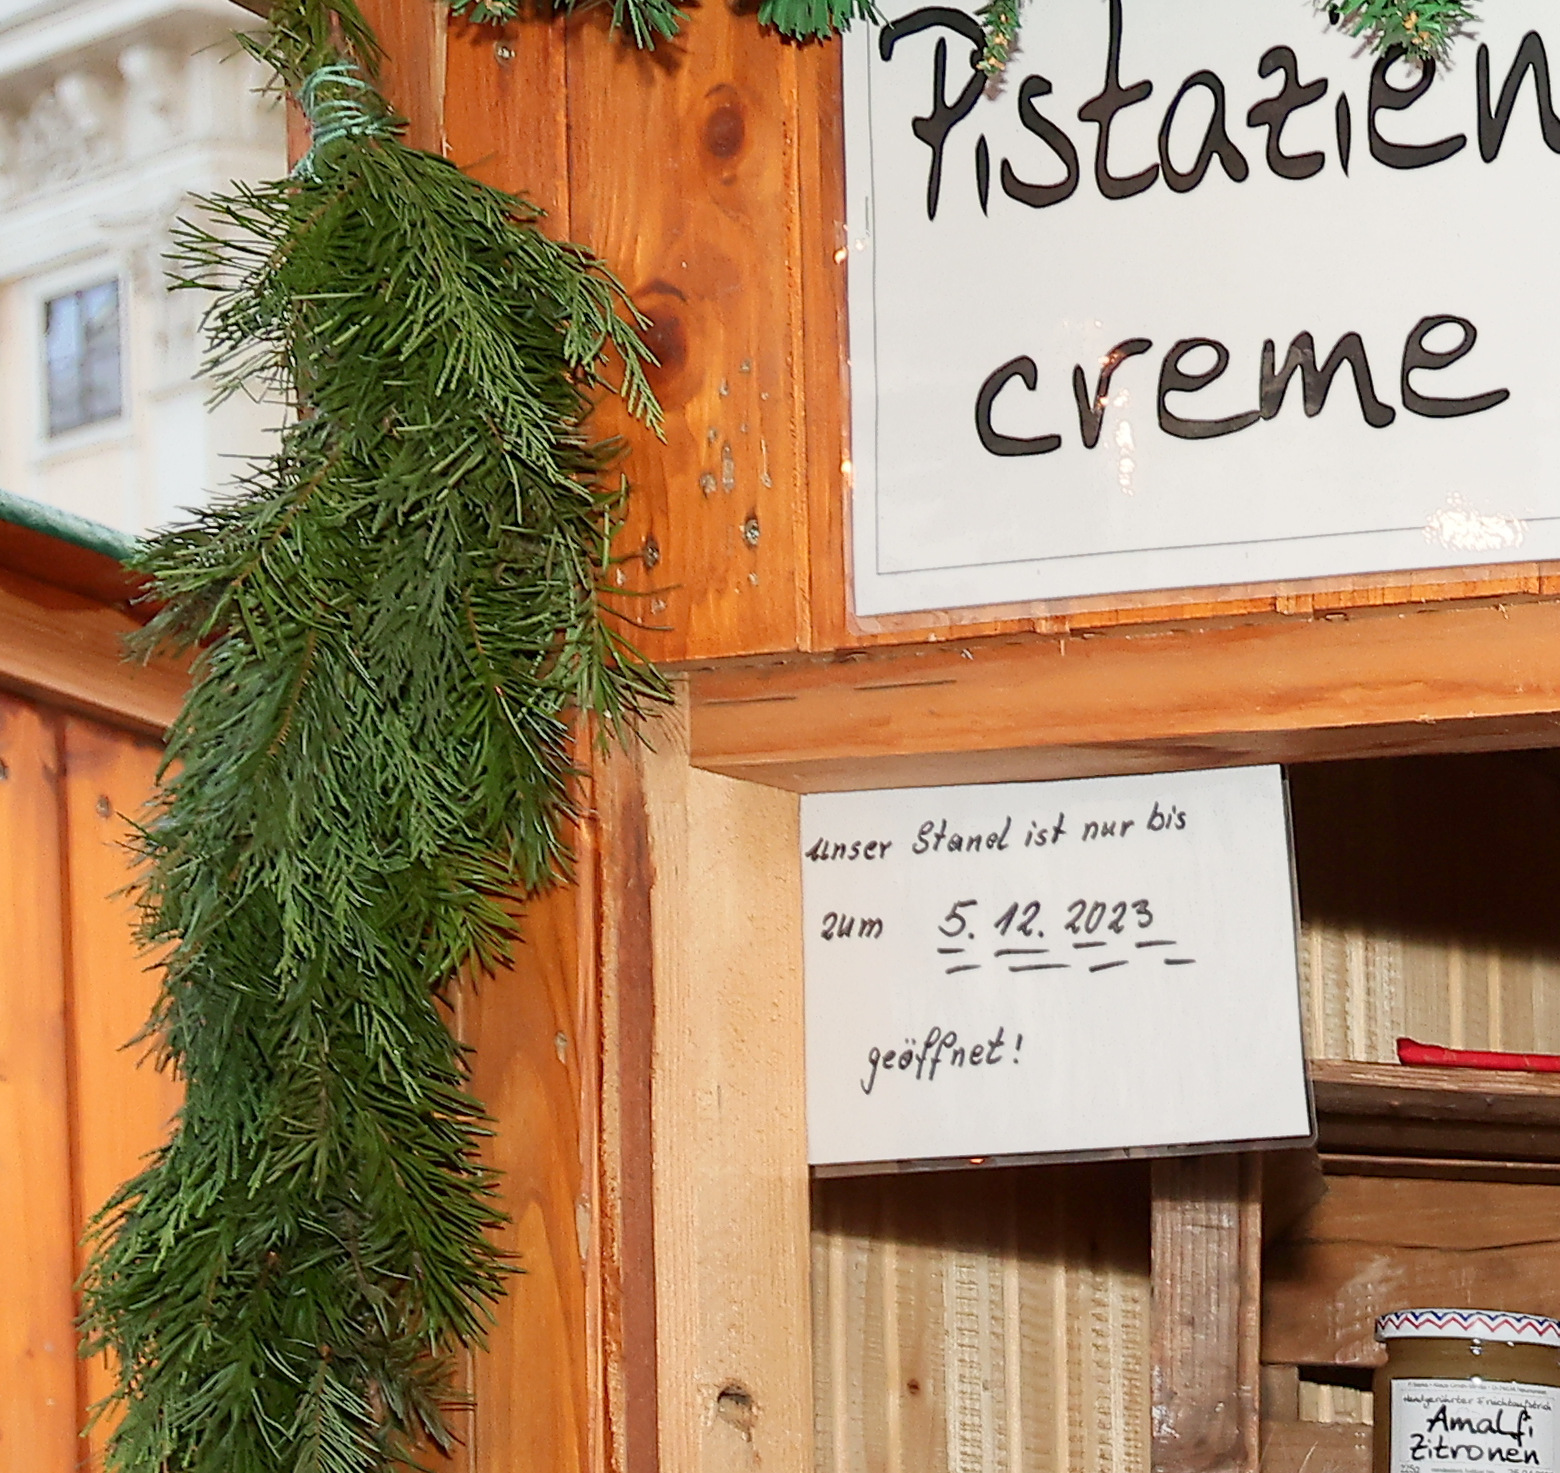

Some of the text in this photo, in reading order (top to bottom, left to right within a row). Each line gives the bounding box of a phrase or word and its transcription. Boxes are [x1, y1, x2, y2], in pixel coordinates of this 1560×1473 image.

[974, 313, 1510, 457] creme
[912, 815, 1010, 855] Stand
[1024, 812, 1067, 848] ist
[1083, 818, 1133, 841] nur
[1147, 801, 1188, 831] bis
[820, 911, 883, 940] zum
[1064, 898, 1154, 935] 2023
[1425, 1405, 1535, 1440] Amalfi
[1409, 1434, 1540, 1466] Zitronen
